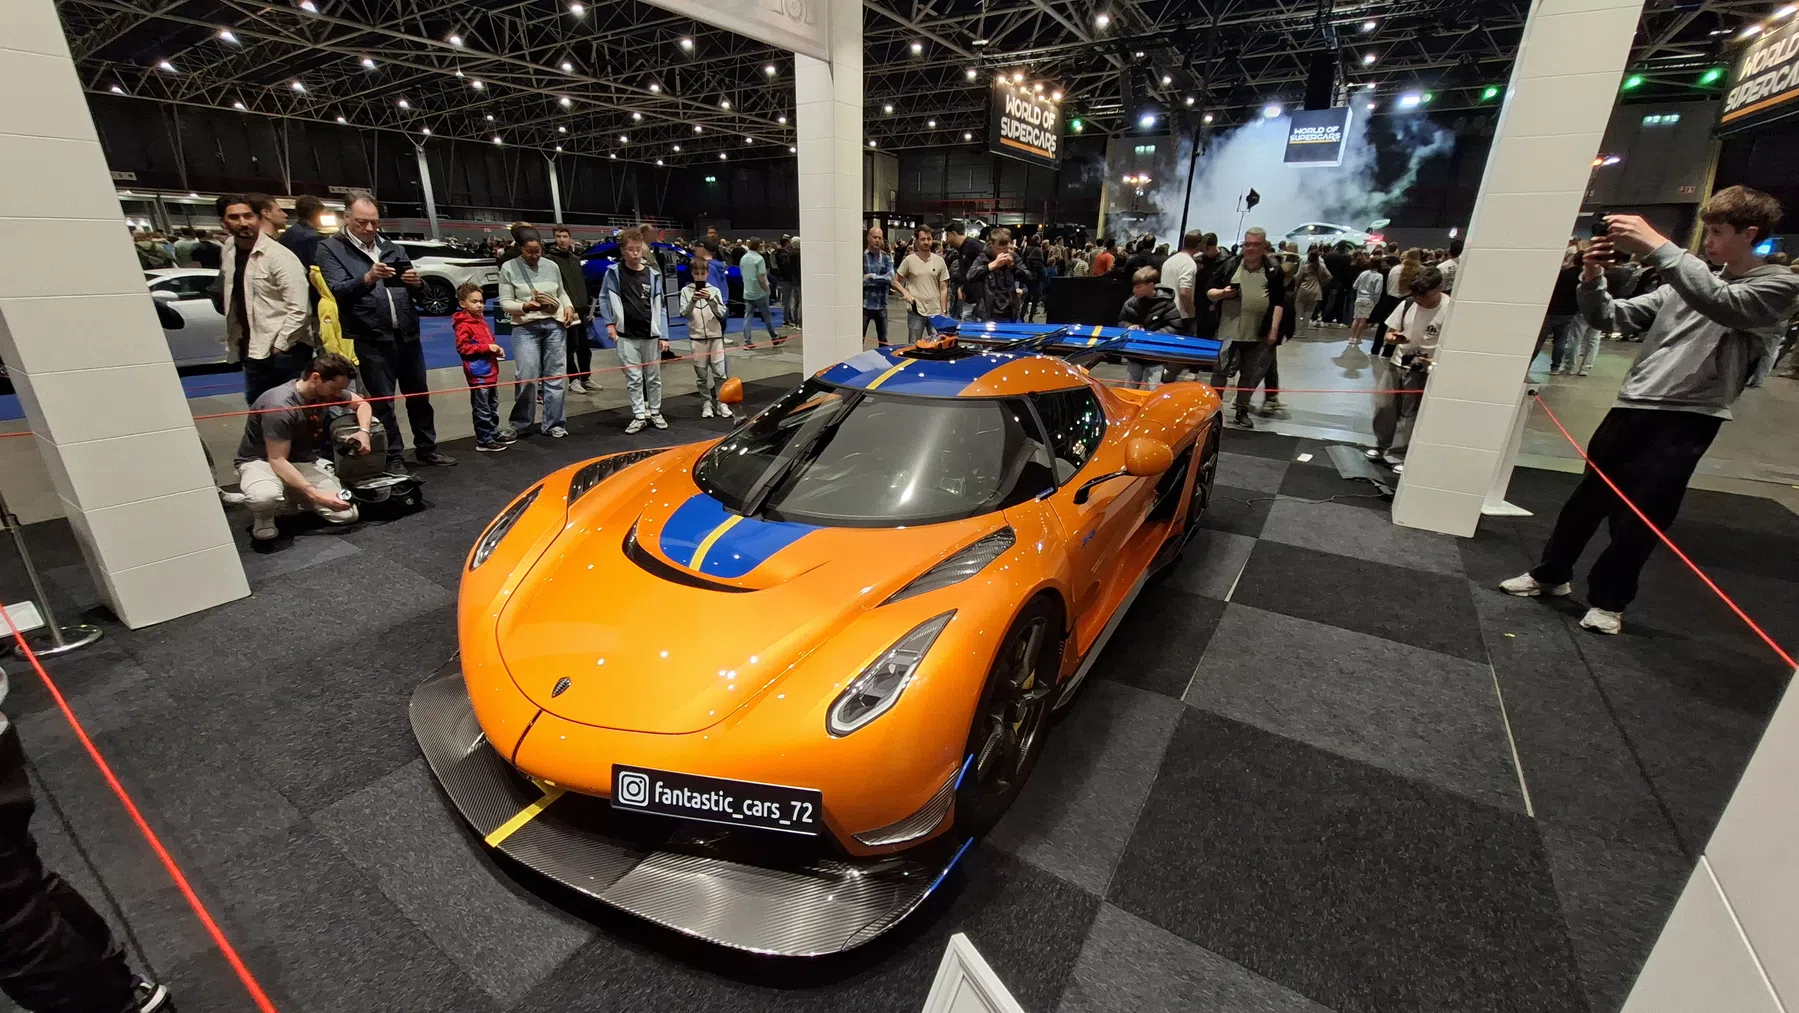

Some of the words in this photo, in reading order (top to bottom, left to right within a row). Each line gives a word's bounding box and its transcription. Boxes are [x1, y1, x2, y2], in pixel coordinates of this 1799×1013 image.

[1738, 32, 1799, 81] WORLD
[1006, 94, 1041, 125] WORLD
[1042, 110, 1056, 130] OF
[1294, 126, 1325, 135] WORLD
[1001, 116, 1057, 158] SUPERCARS
[1290, 133, 1341, 142] SUPERCARS
[655, 781, 813, 825] fantastic_cars_72
